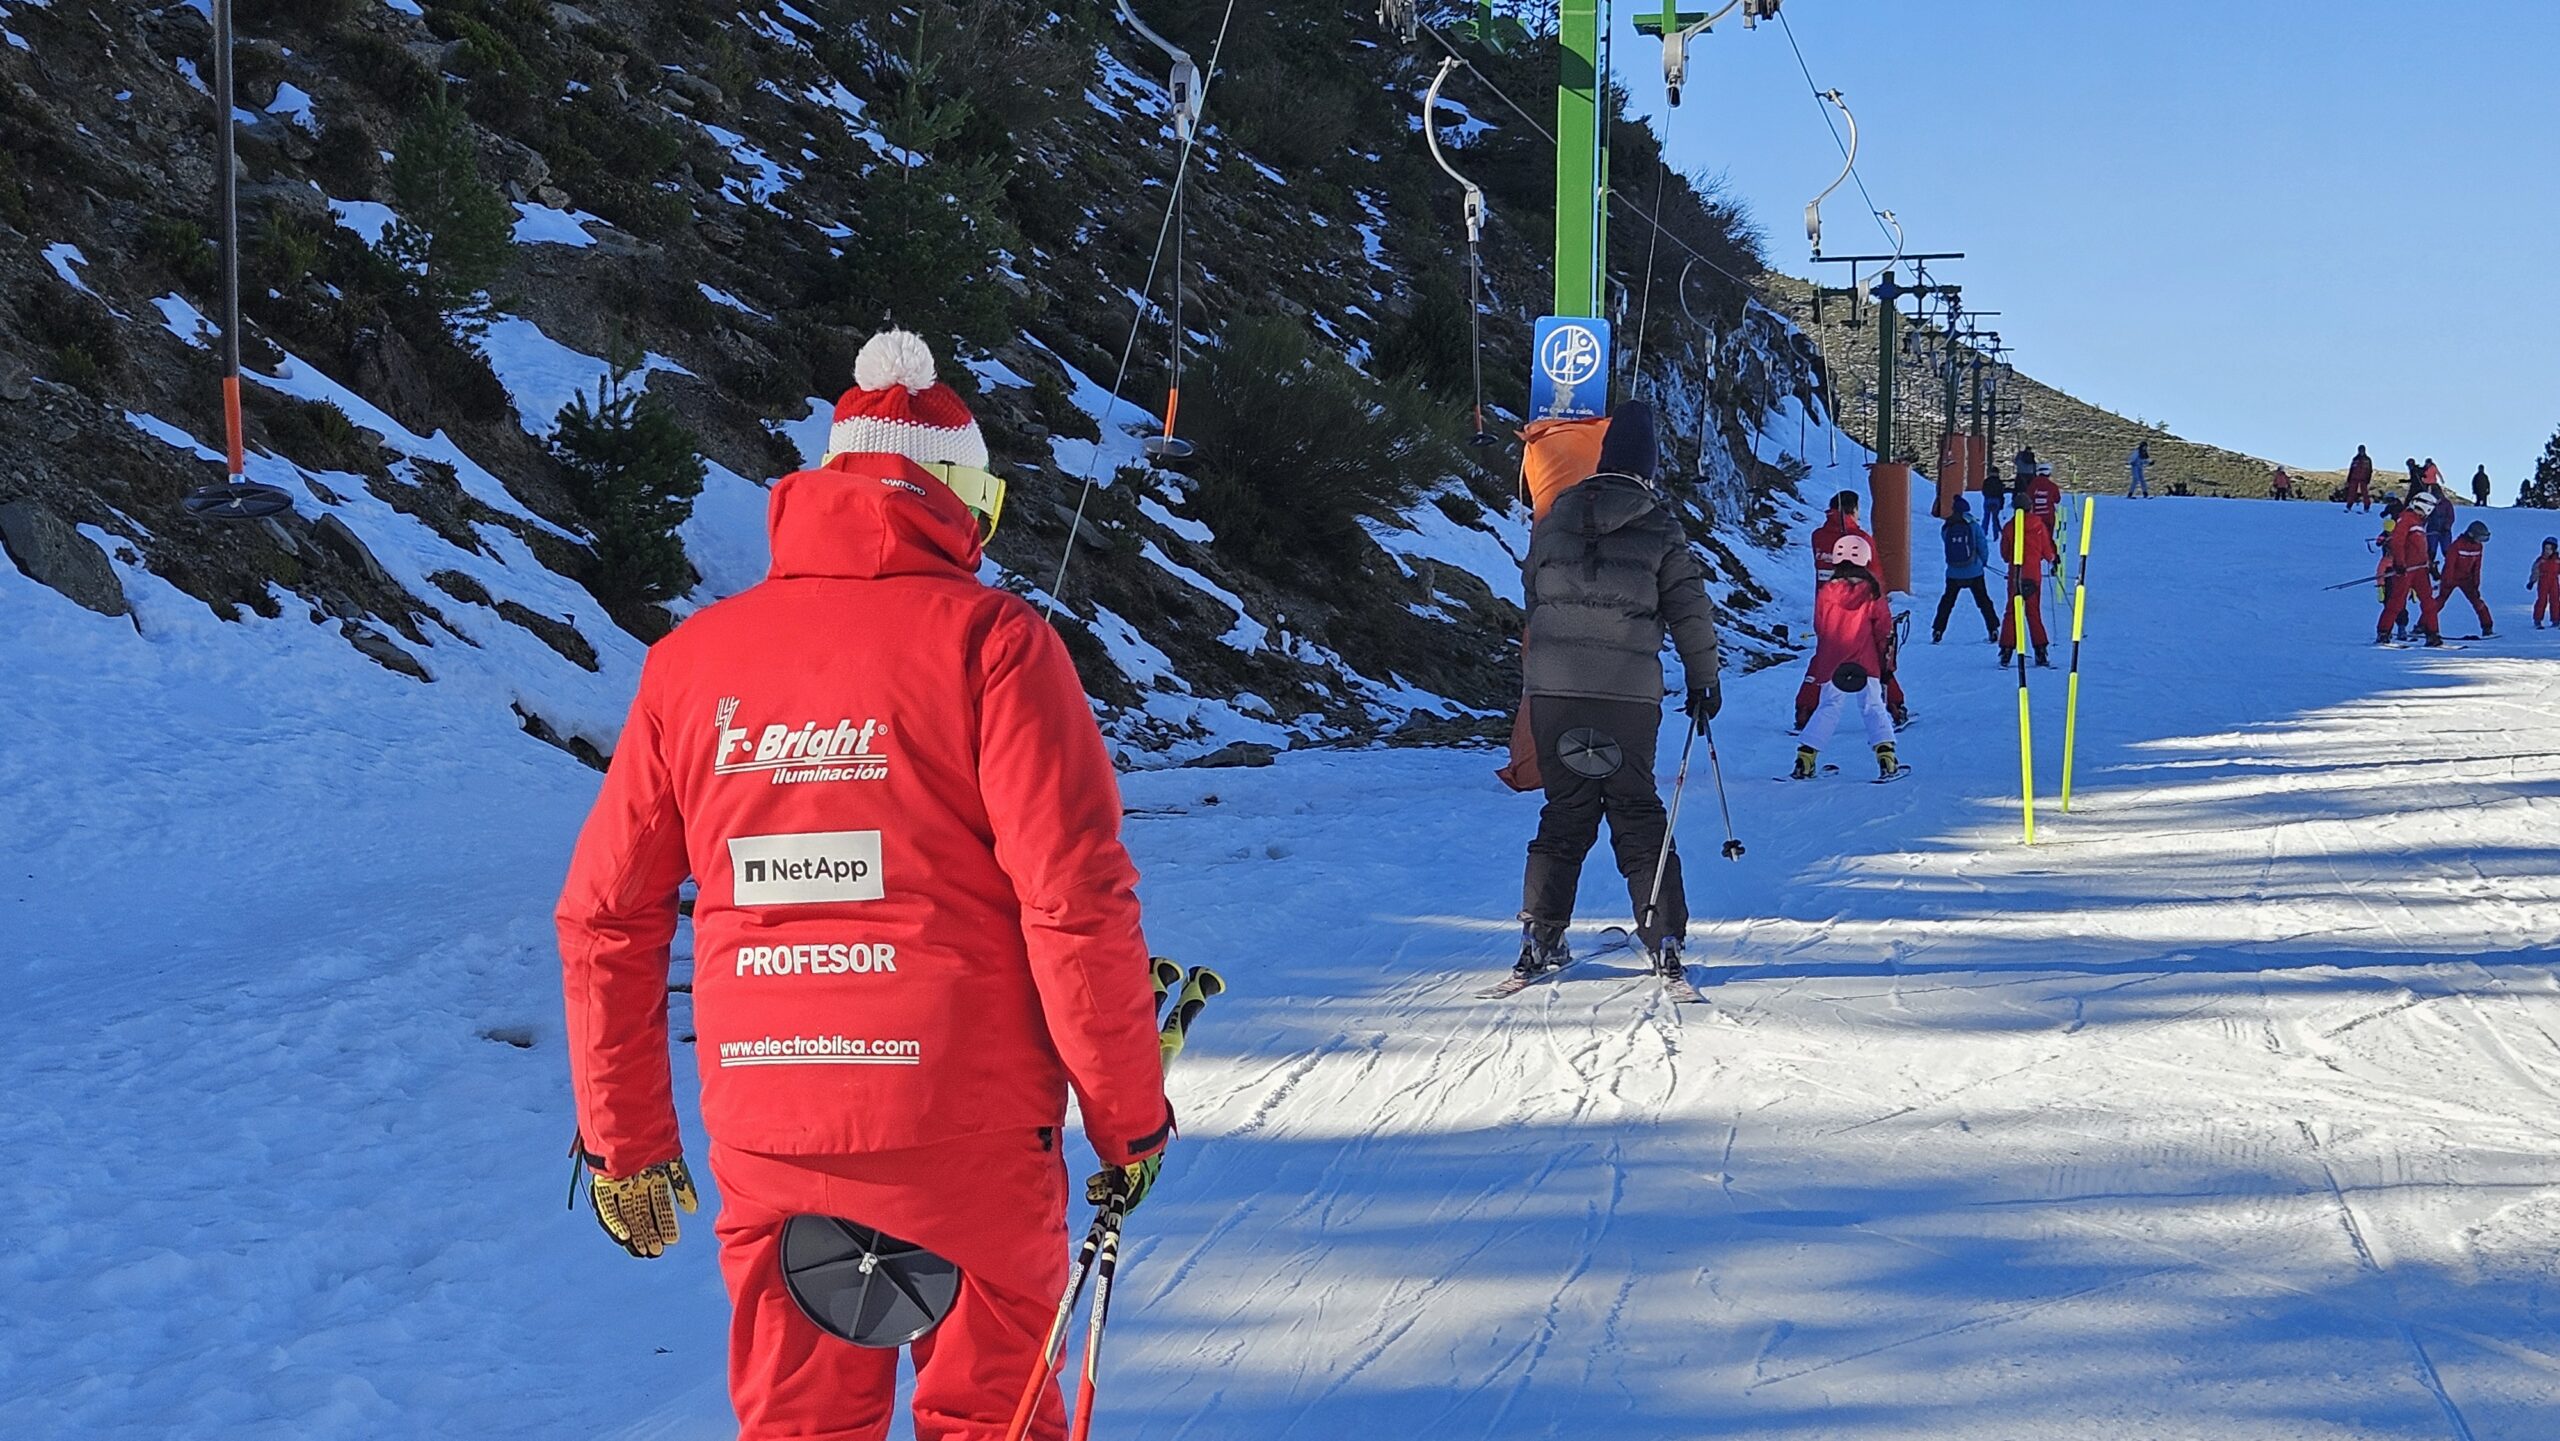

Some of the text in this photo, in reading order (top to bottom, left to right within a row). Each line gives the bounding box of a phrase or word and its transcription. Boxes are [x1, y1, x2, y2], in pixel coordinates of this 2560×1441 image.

[880, 478, 926, 496] SANTOYO
[772, 764, 888, 785] iluminación
[772, 857, 868, 882] NetApp
[736, 943, 897, 977] PROFESOR
[720, 1035, 920, 1058] www.electrobilsa.com
